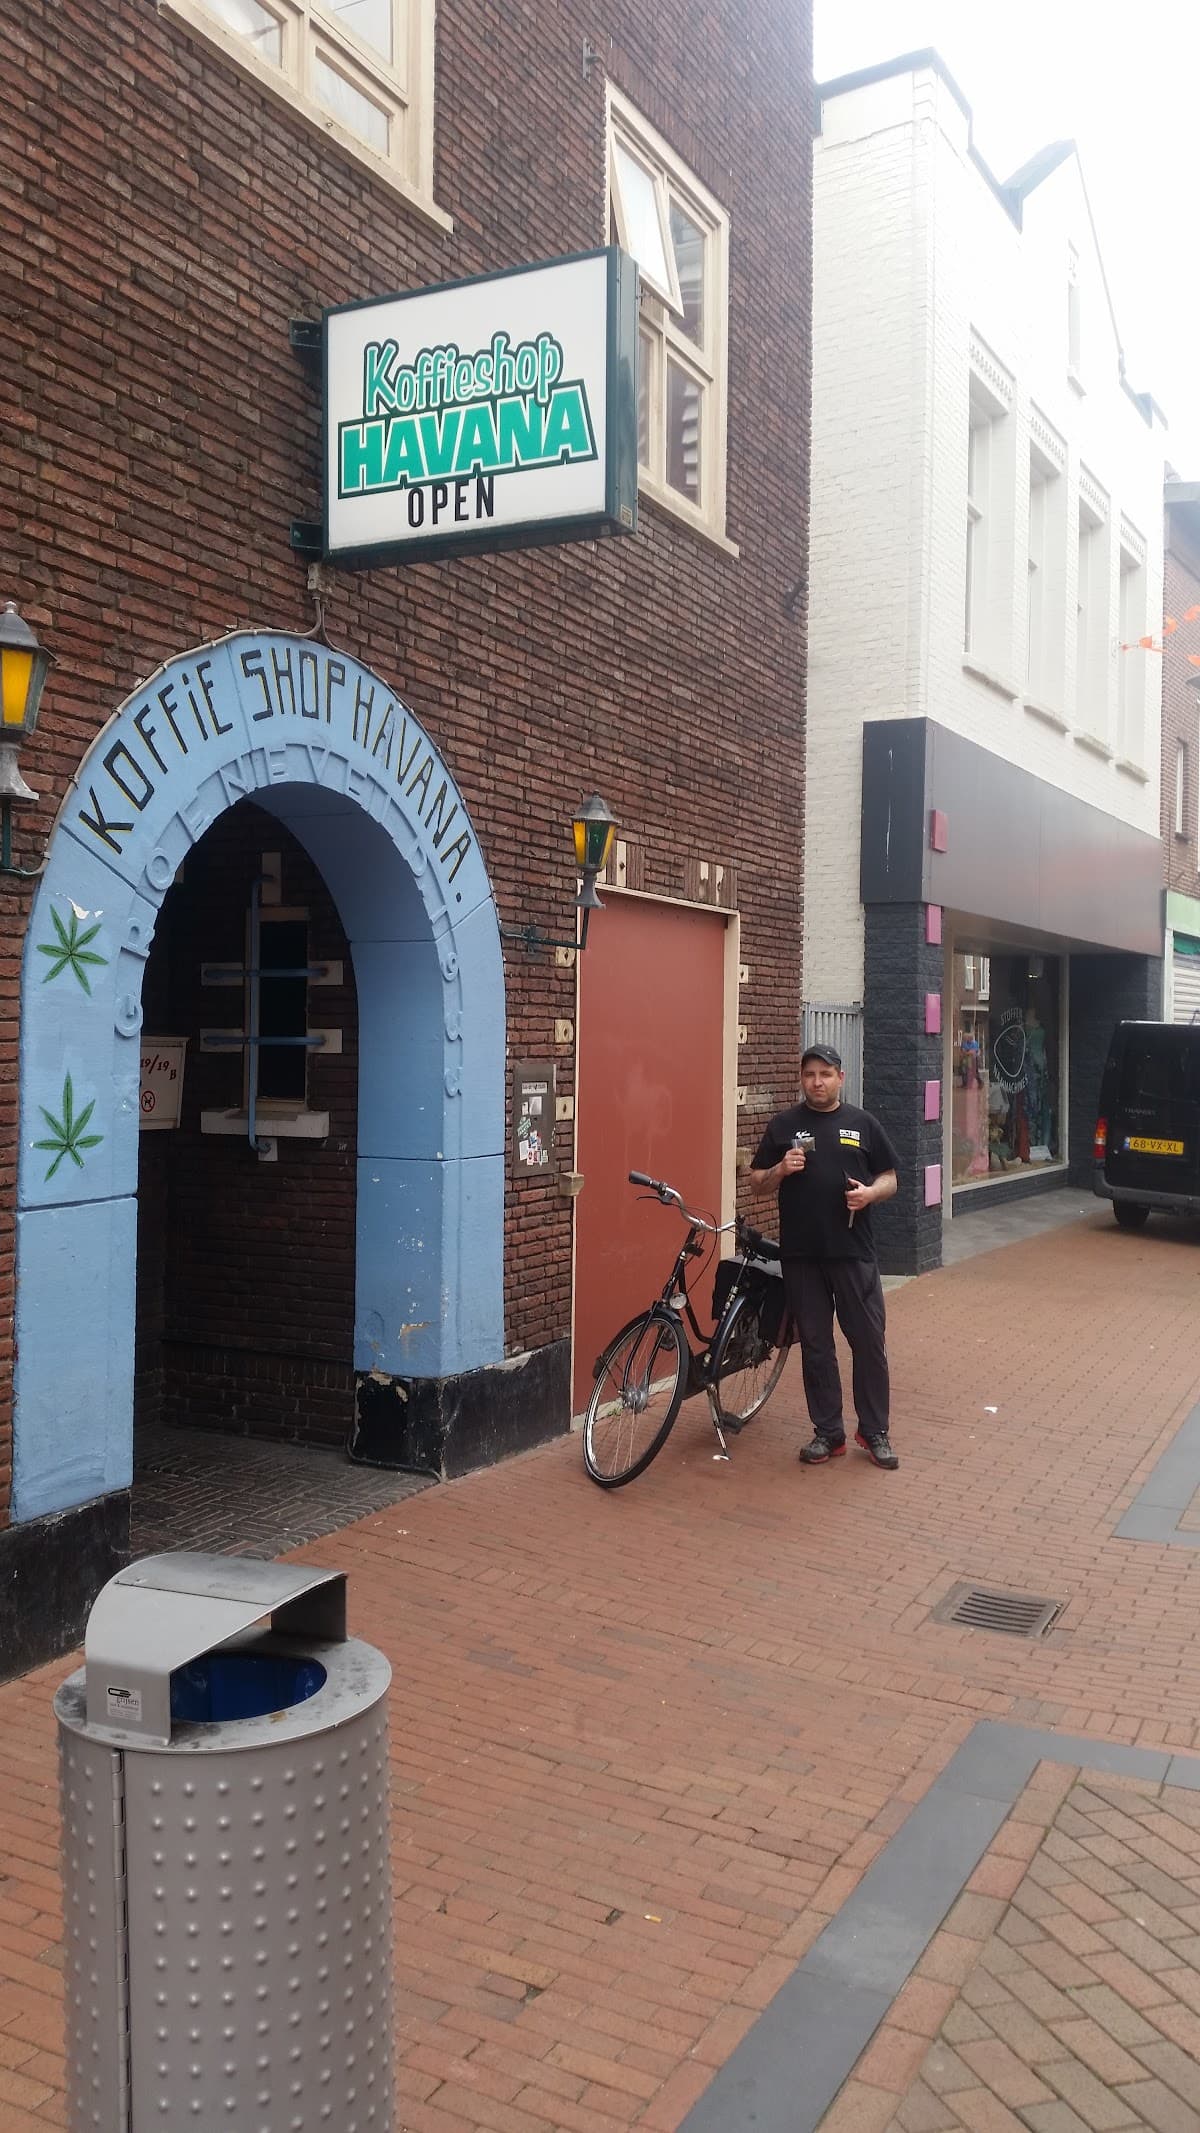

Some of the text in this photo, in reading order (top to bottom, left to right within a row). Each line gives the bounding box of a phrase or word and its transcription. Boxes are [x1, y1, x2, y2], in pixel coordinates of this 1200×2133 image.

[364, 331, 563, 418] Koffieshop
[340, 383, 595, 495] HAVANA
[407, 476, 494, 528] OPEN
[241, 647, 346, 723] SHOP
[1133, 1139, 1179, 1153] 68-VX-XL
